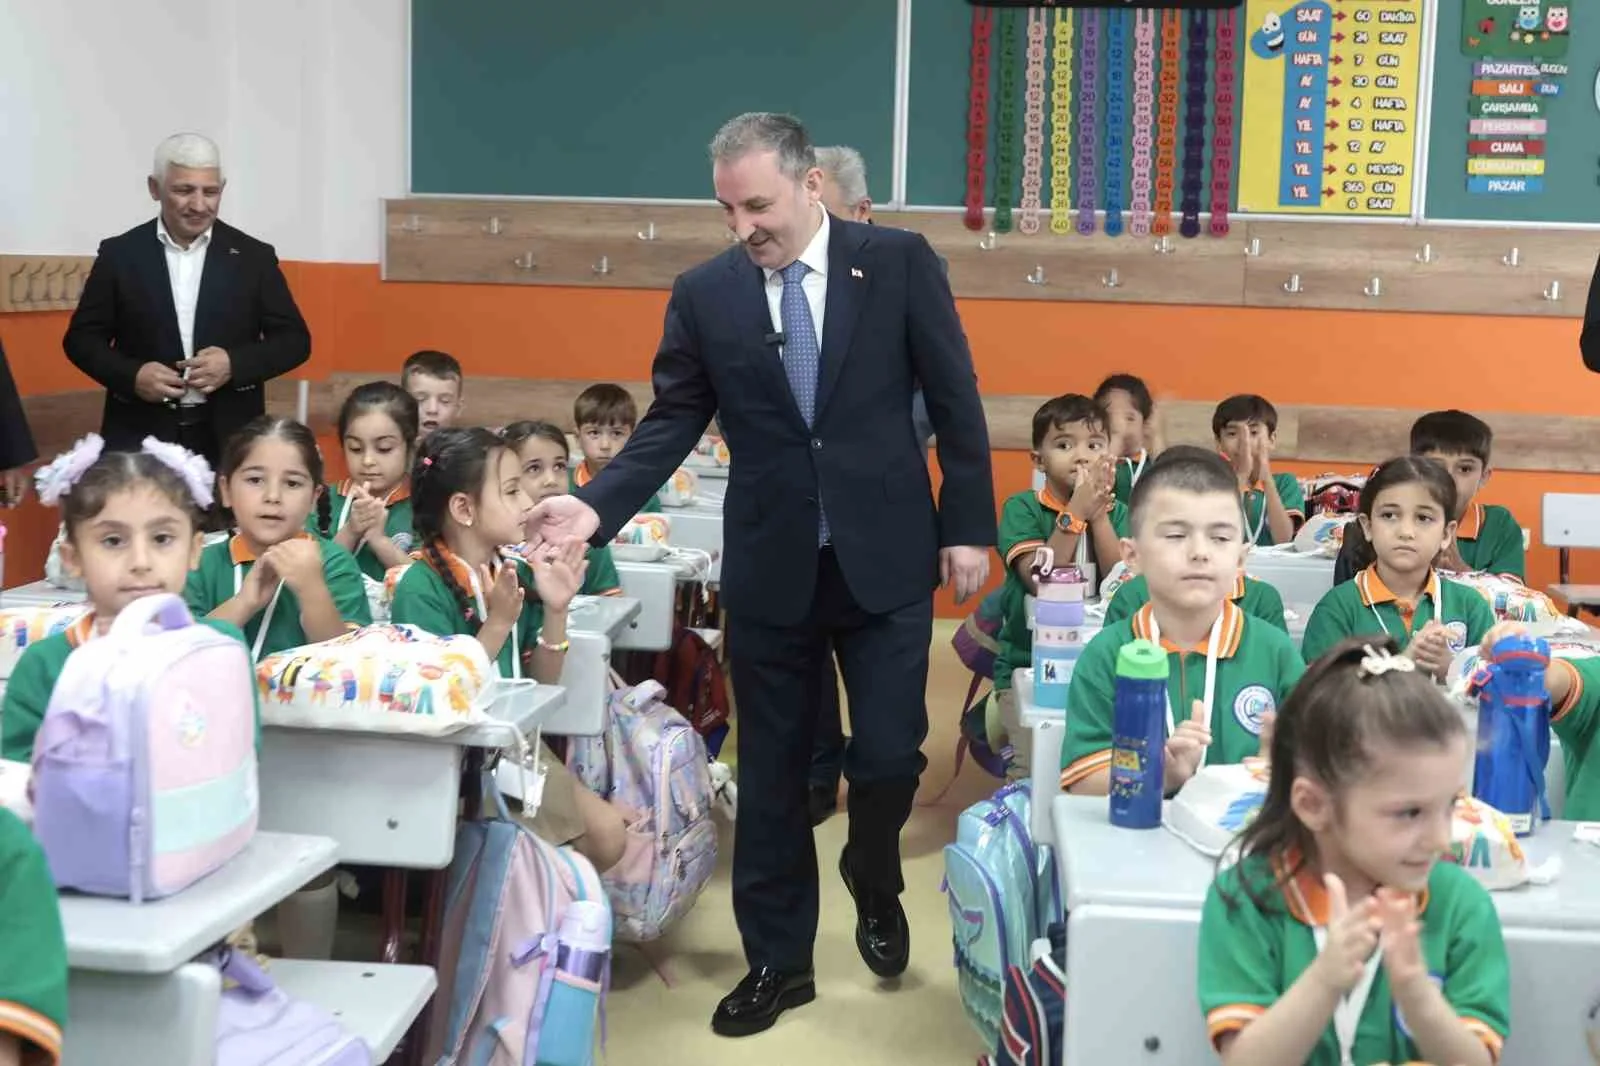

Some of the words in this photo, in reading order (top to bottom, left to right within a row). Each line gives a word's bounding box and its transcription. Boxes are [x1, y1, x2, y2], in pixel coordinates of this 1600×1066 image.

[1297, 8, 1323, 22] SAAT
[1355, 10, 1371, 22] 60
[1221, 28, 1232, 37] 10
[1298, 30, 1317, 42] GÜN
[1354, 32, 1368, 43] 24
[1380, 32, 1406, 44] SAAT
[1084, 50, 1096, 58] 10
[1138, 50, 1150, 58] 14
[1220, 50, 1232, 60] 20
[1294, 53, 1322, 66] HAFTA
[1355, 55, 1363, 65] 7
[1056, 71, 1067, 80] 12
[1084, 71, 1094, 80] 15
[1138, 72, 1150, 80] 21
[1162, 72, 1176, 80] 24
[1300, 74, 1312, 87] AY
[1352, 76, 1368, 87] 30
[1498, 83, 1524, 94] SALI
[1030, 92, 1040, 100] 12
[1082, 92, 1095, 101] 20
[1162, 94, 1176, 102] 32
[1300, 96, 1312, 108] AY
[1352, 97, 1361, 108] 4
[1374, 97, 1406, 110] HAFTA
[1482, 102, 1538, 114] ÇARŞAMBA
[1030, 114, 1039, 122] 15
[1056, 114, 1068, 122] 20
[1082, 114, 1094, 123] 25
[1136, 114, 1150, 124] 35
[1217, 116, 1232, 125] 50
[1373, 119, 1405, 132] HAFTA
[1055, 135, 1068, 144] 24
[1136, 137, 1149, 146] 42
[1348, 141, 1360, 152] 12
[1370, 141, 1385, 153] AY
[1490, 142, 1524, 153] CUMA
[1028, 157, 1038, 166] 21
[1081, 157, 1094, 166] 35
[1136, 158, 1149, 168] 49
[1159, 159, 1173, 168] 56
[1217, 159, 1230, 168] 70
[1348, 164, 1356, 174] 4
[1027, 178, 1038, 187] 24
[1054, 178, 1067, 186] 32
[1081, 179, 1094, 188] 40
[1134, 180, 1148, 190] 56
[1158, 180, 1172, 190] 64
[1488, 180, 1526, 192] PAZAR
[1344, 181, 1364, 193] 365
[1026, 200, 1037, 208] 27
[1080, 200, 1094, 209] 45
[1156, 202, 1170, 211] 72
[1348, 198, 1358, 209] 6
[1368, 198, 1393, 209] SAAT
[1024, 222, 1036, 231] 30
[1054, 221, 1068, 230] 40
[1080, 222, 1094, 232] 50
[1134, 224, 1148, 233] 70
[1155, 224, 1169, 232] 80
[1212, 224, 1229, 233] 100
